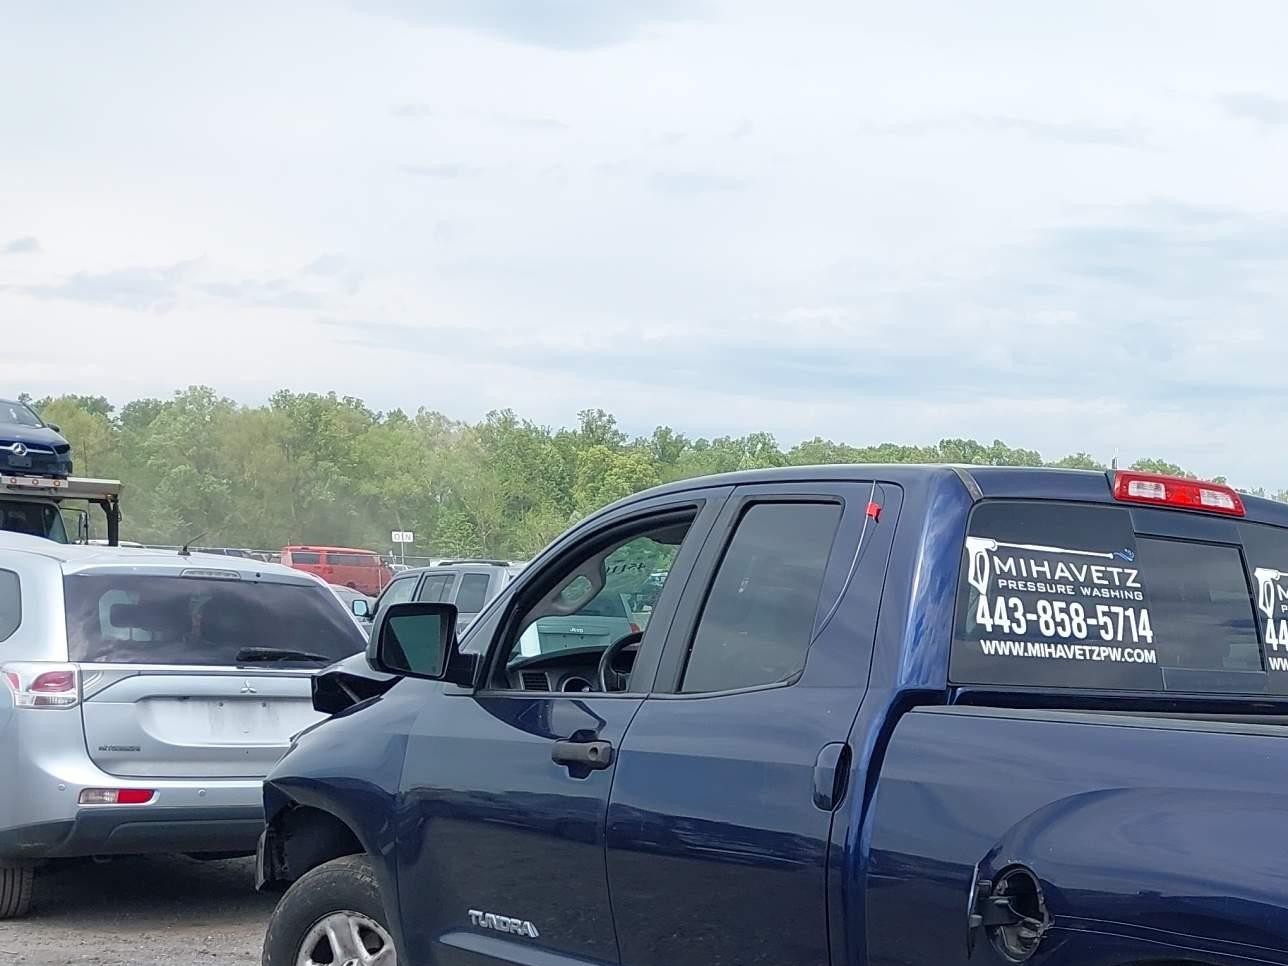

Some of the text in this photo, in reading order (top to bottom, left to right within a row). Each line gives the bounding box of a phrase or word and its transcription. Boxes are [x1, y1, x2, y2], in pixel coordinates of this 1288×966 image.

[993, 556, 1142, 588] MIHAVETZ
[998, 579, 1144, 601] PRESSURE WASHING
[976, 595, 1154, 644] 443-858-5714
[979, 639, 1157, 664] WWW.MIHAVETZPW.COM
[468, 909, 540, 938] TUNDRA
